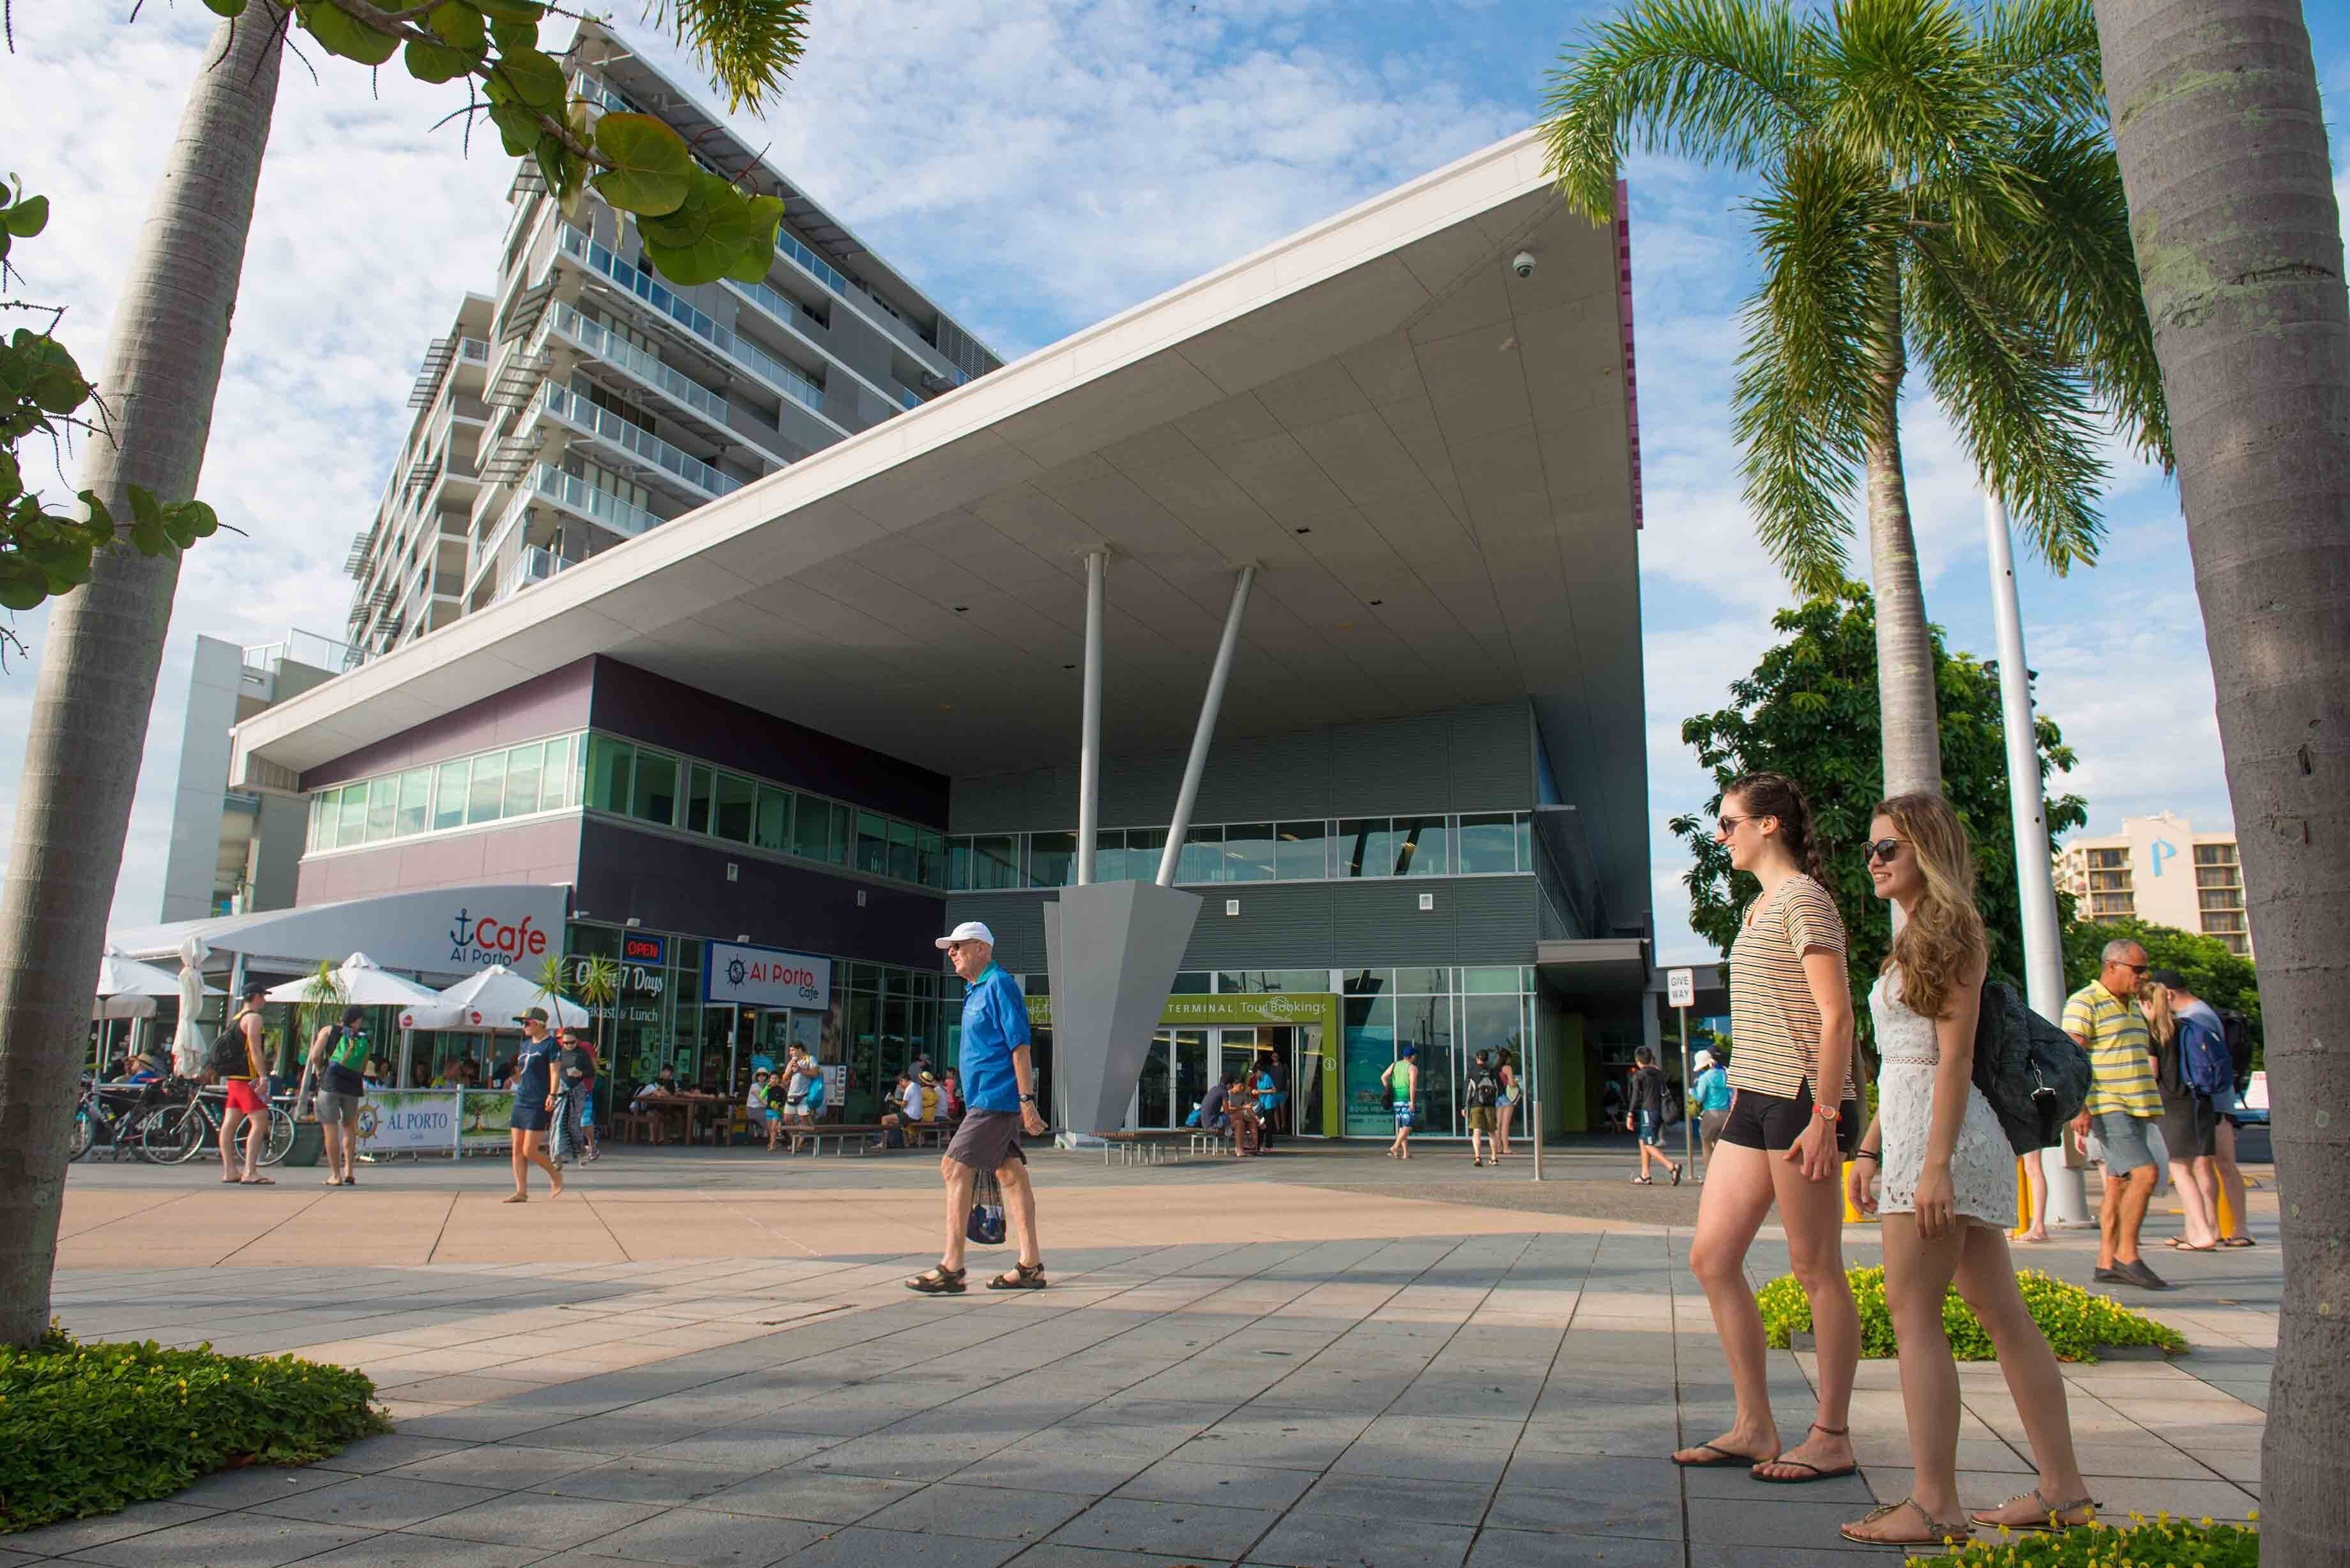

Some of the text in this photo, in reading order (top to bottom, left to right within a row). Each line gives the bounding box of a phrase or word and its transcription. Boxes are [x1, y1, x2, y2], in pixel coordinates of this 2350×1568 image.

[476, 916, 547, 962] Cafe
[628, 941, 658, 957] OPEN
[472, 949, 512, 966] Porto
[622, 966, 630, 988] 7
[633, 967, 662, 997] Days
[750, 962, 813, 987] Al Porto
[1671, 976, 1689, 986] GIVE
[799, 986, 819, 1001] Cafe
[1671, 990, 1690, 999] WAY
[630, 1007, 658, 1022] Lunch
[1168, 1004, 1233, 1013] TERMINAL
[1271, 1001, 1326, 1015] Bookings
[388, 1113, 448, 1129] AL PORTO
